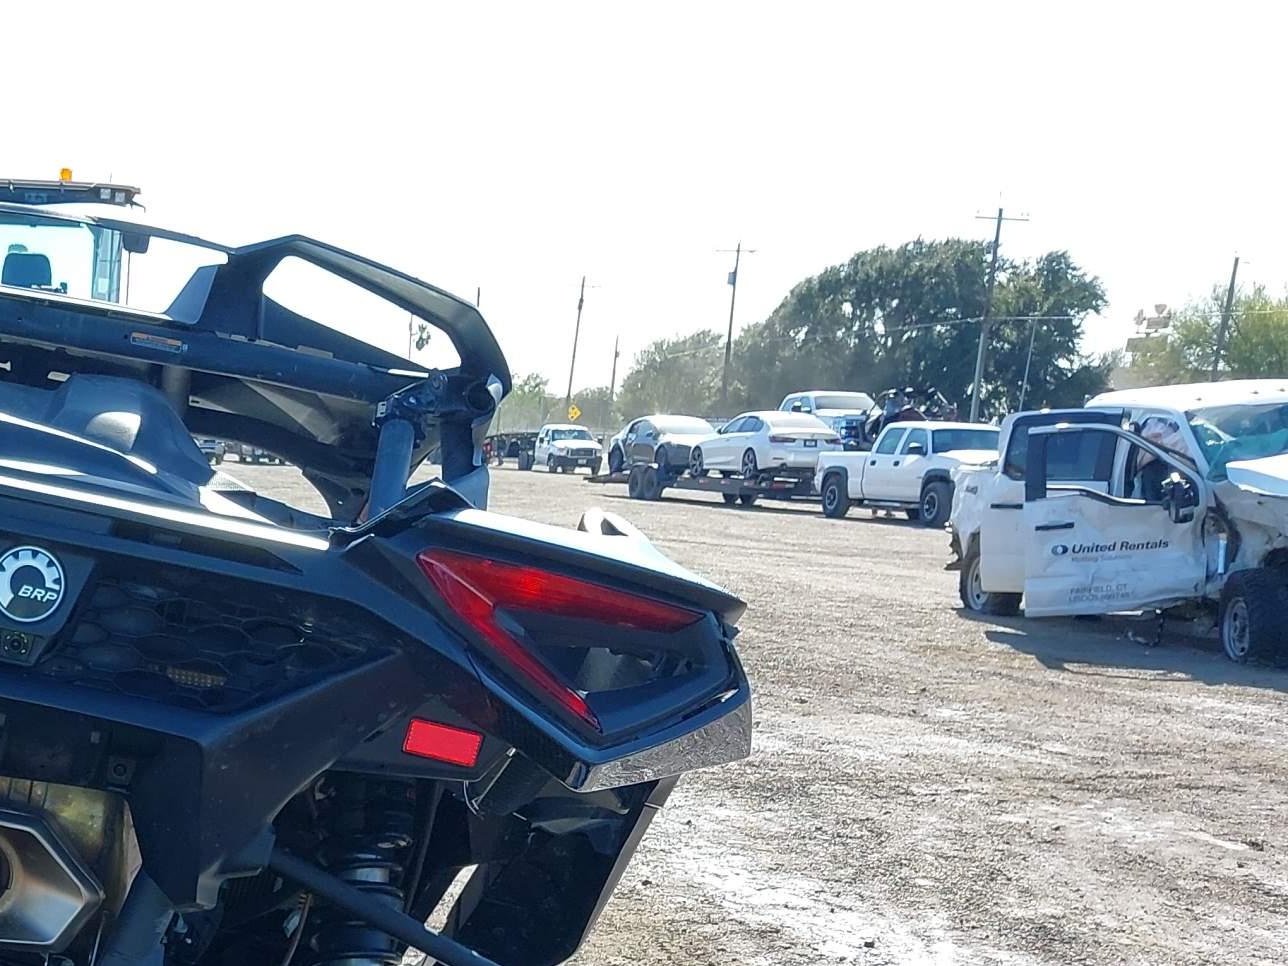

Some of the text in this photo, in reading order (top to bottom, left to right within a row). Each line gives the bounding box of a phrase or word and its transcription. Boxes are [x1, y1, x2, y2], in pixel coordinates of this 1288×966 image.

[1071, 539, 1169, 555] United Rentals
[18, 584, 57, 602] BRP
